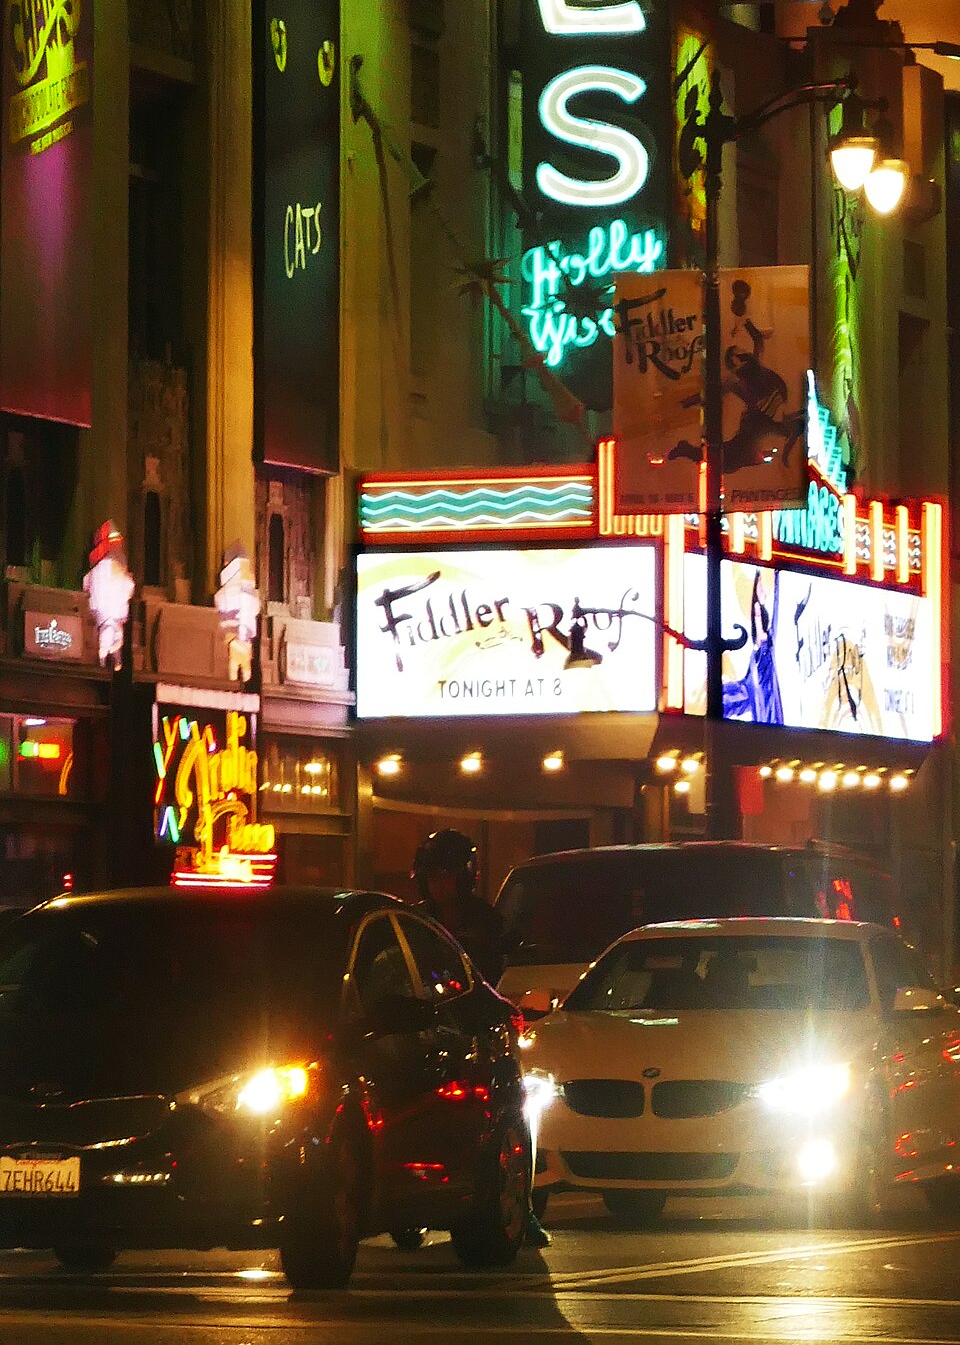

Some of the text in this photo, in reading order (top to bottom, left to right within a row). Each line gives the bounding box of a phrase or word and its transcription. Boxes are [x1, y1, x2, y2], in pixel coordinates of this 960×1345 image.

[284, 202, 322, 279] CATS
[614, 287, 698, 366] Fiddler
[374, 570, 509, 672] Fiddler
[438, 677, 563, 699] TONIGHT AT 8
[2, 1170, 76, 1191] 7EHR644
